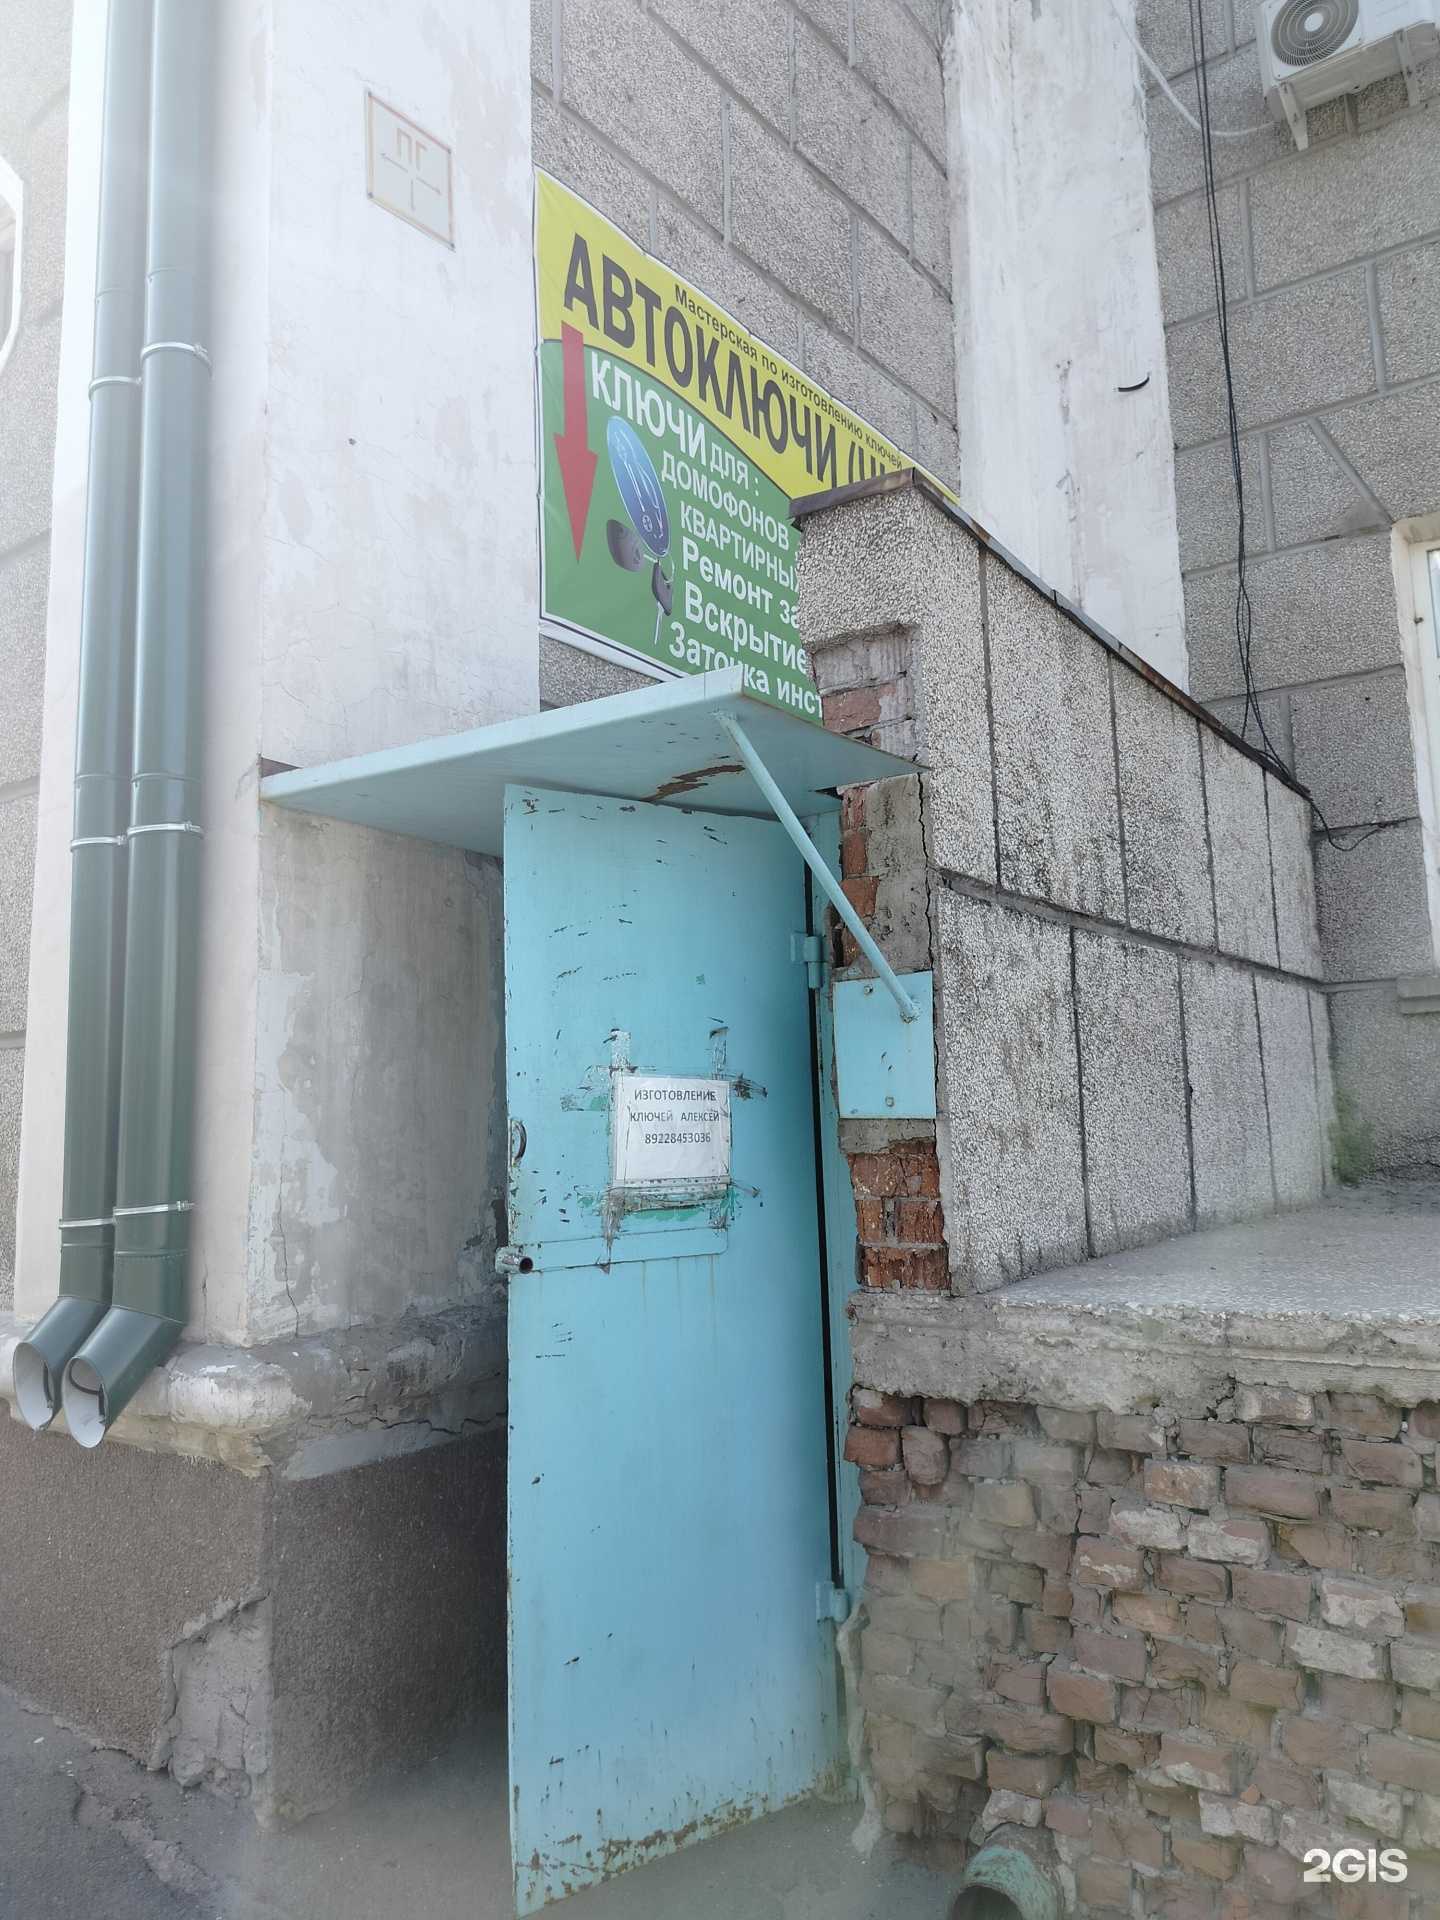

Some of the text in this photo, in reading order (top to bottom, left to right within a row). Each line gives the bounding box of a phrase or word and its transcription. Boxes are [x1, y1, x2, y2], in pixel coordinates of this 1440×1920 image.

[397, 126, 428, 172] ПГ
[563, 233, 838, 488] АВТОКЛЮЧИ
[675, 284, 758, 361] Мастерская
[761, 355, 778, 375] по
[781, 369, 863, 439] изготовлению
[865, 432, 903, 470] ключей
[591, 350, 707, 467] КЛЮЧИ
[661, 450, 789, 551] ДОМОФОНОВ
[682, 535, 773, 615] Ремонт
[684, 581, 807, 675] Вскрытие
[630, 1110, 720, 1122] КЛЮЧЕЙ АЛЕКСЕЙ
[634, 1089, 717, 1101] ИЗГОТОВЛЕНИЕ
[644, 1132, 711, 1144] 89228453036
